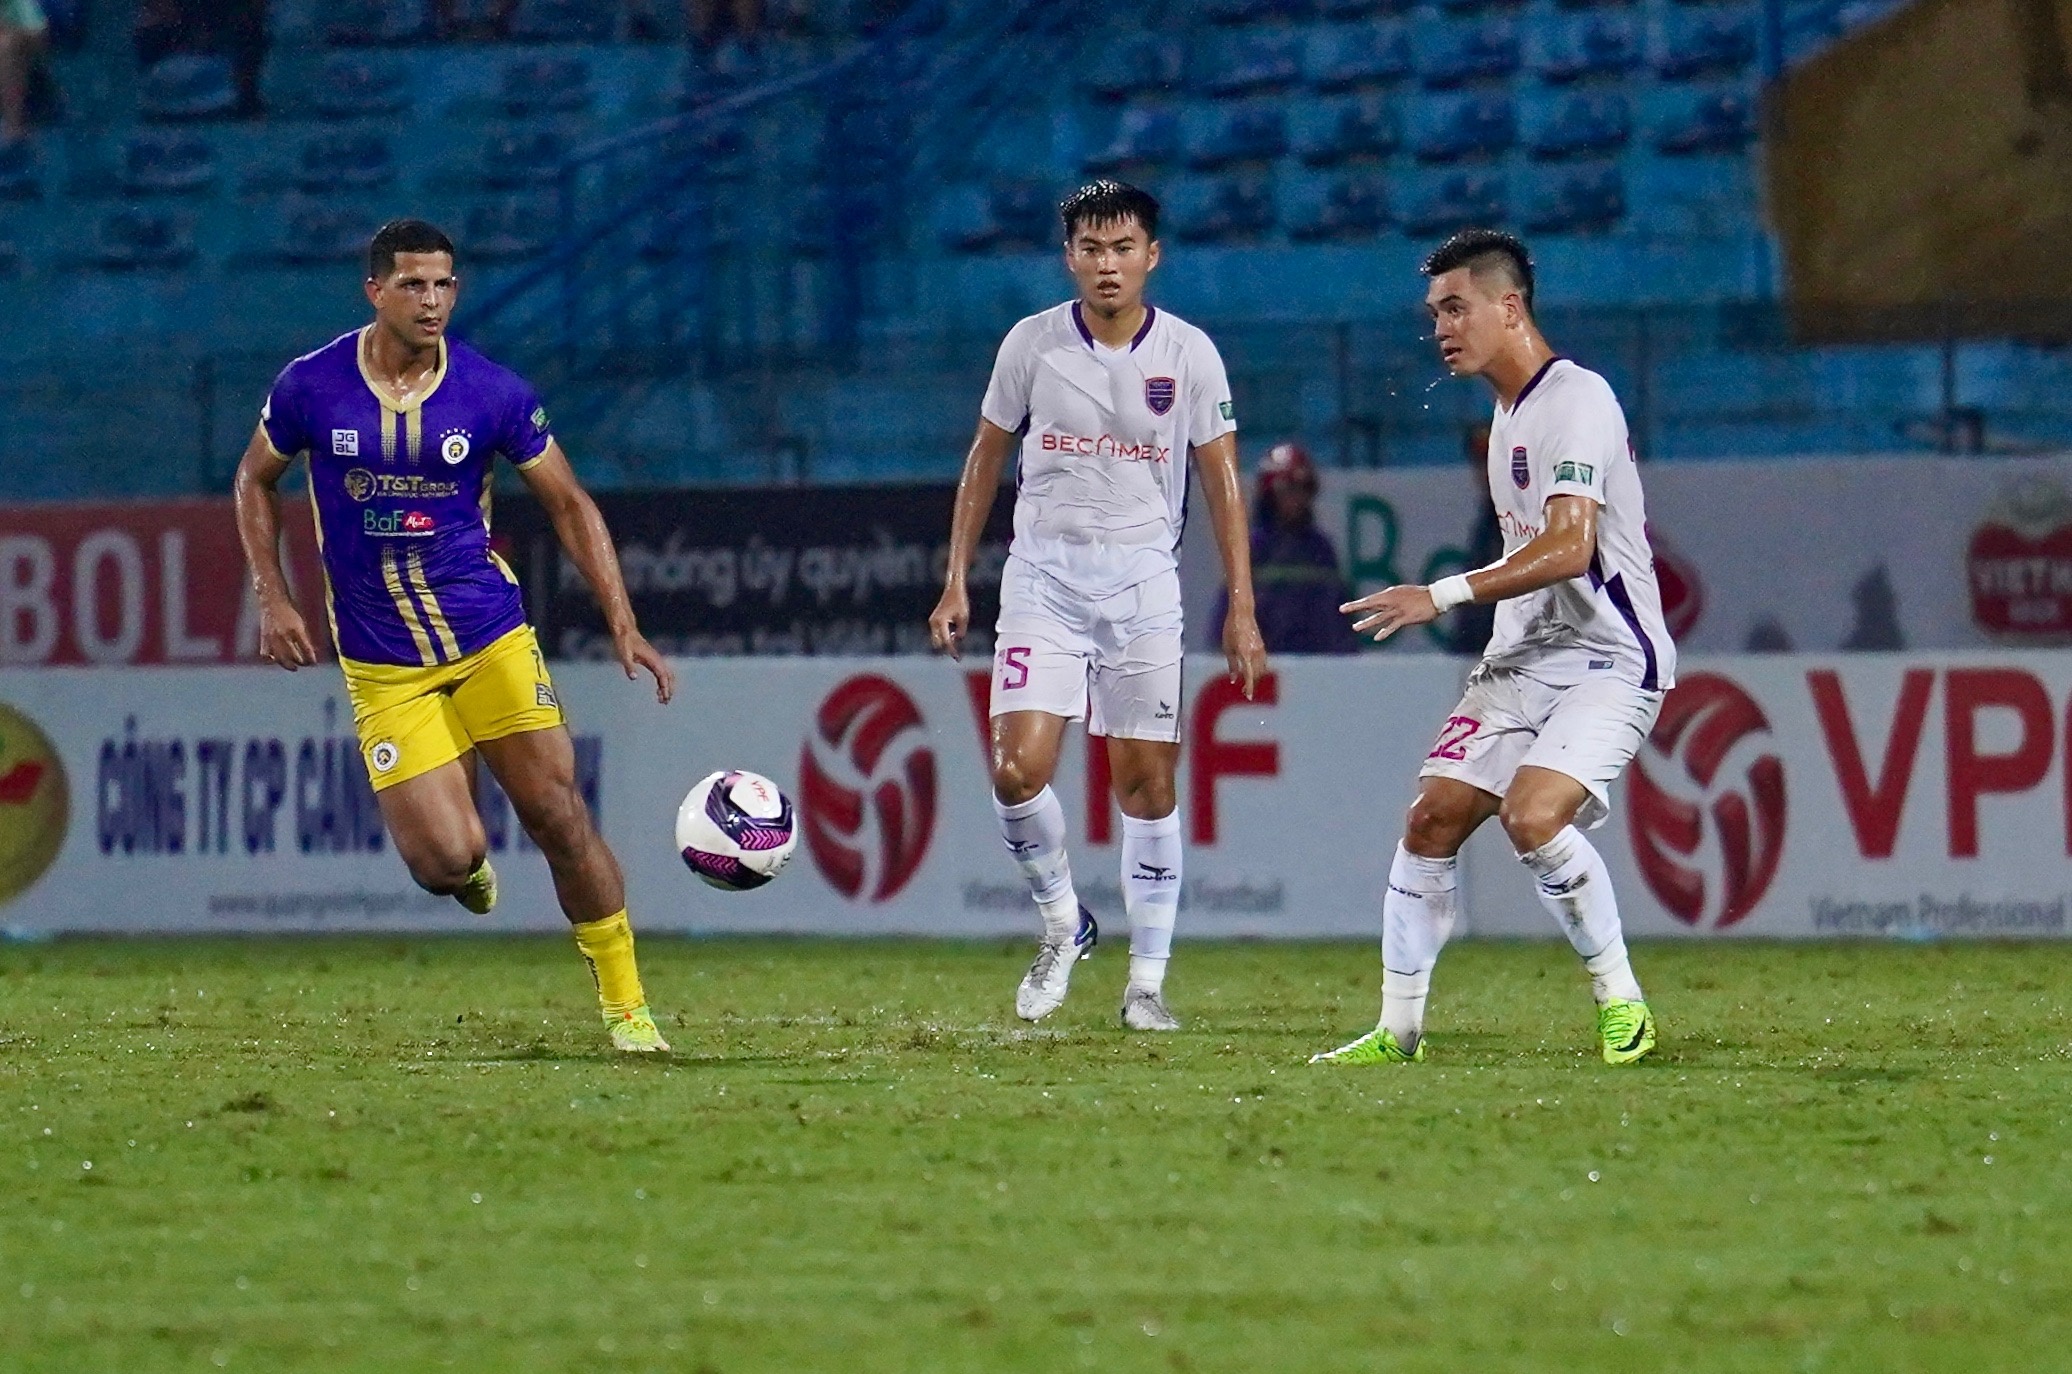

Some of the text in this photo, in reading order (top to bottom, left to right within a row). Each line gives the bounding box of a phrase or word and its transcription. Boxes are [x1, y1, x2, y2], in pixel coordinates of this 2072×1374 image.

[1041, 433, 1170, 463] BECAMEX
[377, 475, 424, 491] T&T
[363, 508, 405, 532] BaF
[998, 647, 1031, 690] 5
[1808, 668, 2072, 859] VP
